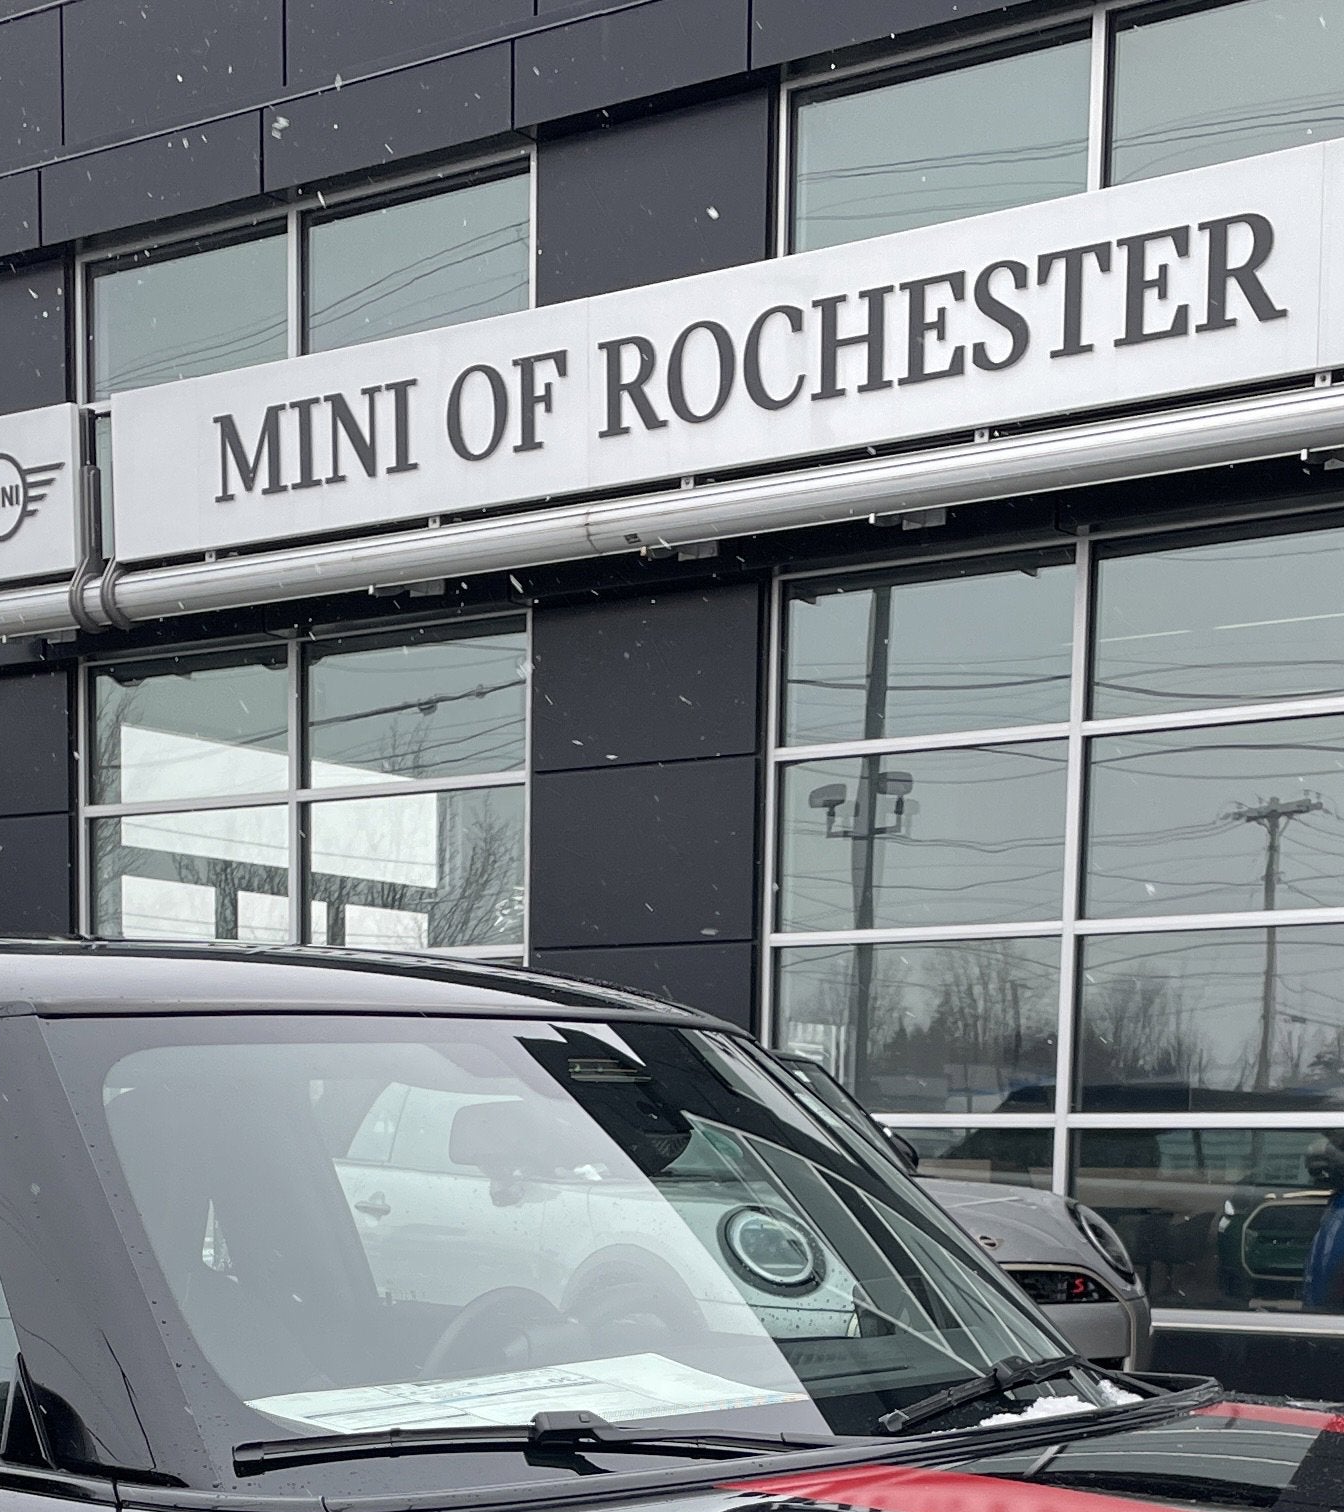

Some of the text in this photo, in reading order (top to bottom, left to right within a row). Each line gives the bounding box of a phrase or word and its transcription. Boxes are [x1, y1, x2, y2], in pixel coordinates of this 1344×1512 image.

[213, 213, 1287, 503] MINI OF ROCHESTER
